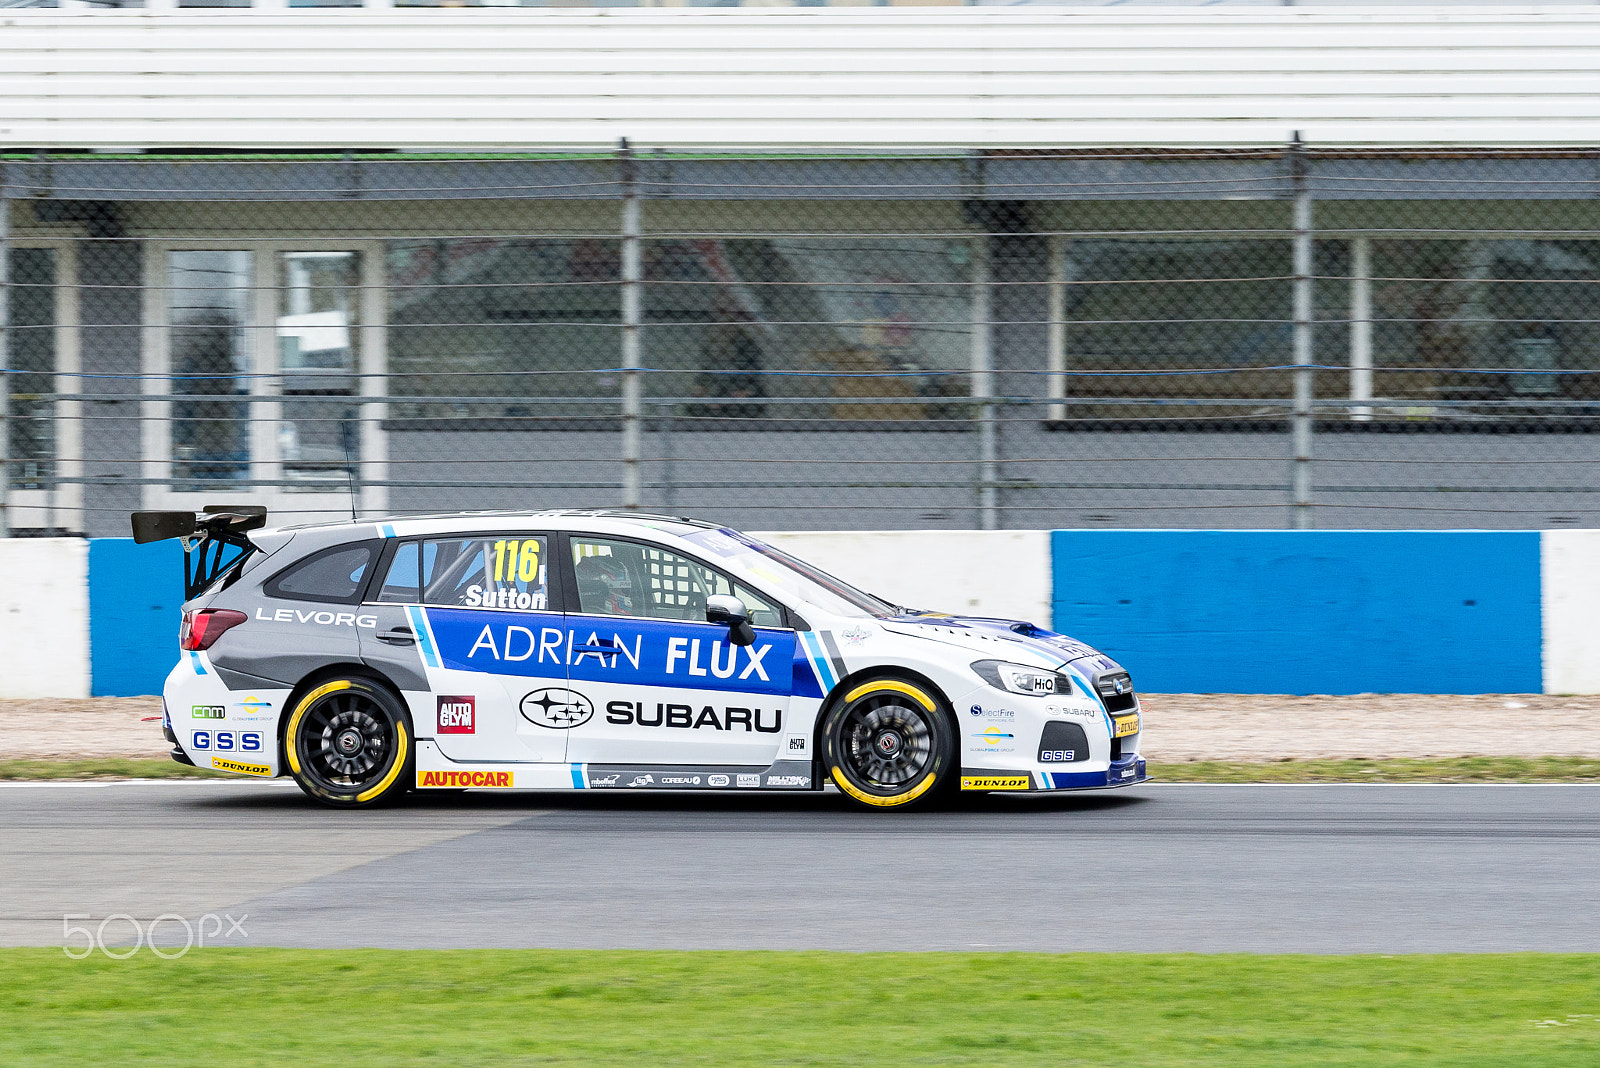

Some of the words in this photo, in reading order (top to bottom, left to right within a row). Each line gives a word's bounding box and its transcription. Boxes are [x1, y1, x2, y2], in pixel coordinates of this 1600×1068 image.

[494, 539, 540, 582] 116
[465, 584, 546, 610] Sutton
[255, 607, 377, 629] LEVORG
[467, 623, 643, 670] ADRIAN
[665, 636, 773, 682] FLUX
[1034, 678, 1053, 691] HiQ
[440, 703, 472, 715] AUTO
[1063, 708, 1095, 718] SUBARU
[440, 713, 472, 726] GLYM
[606, 700, 782, 733] SUBARU
[193, 732, 260, 750] GSS
[1042, 752, 1073, 760] GSS
[222, 762, 269, 773] DUNLOP
[423, 772, 509, 786] AUTOCAR
